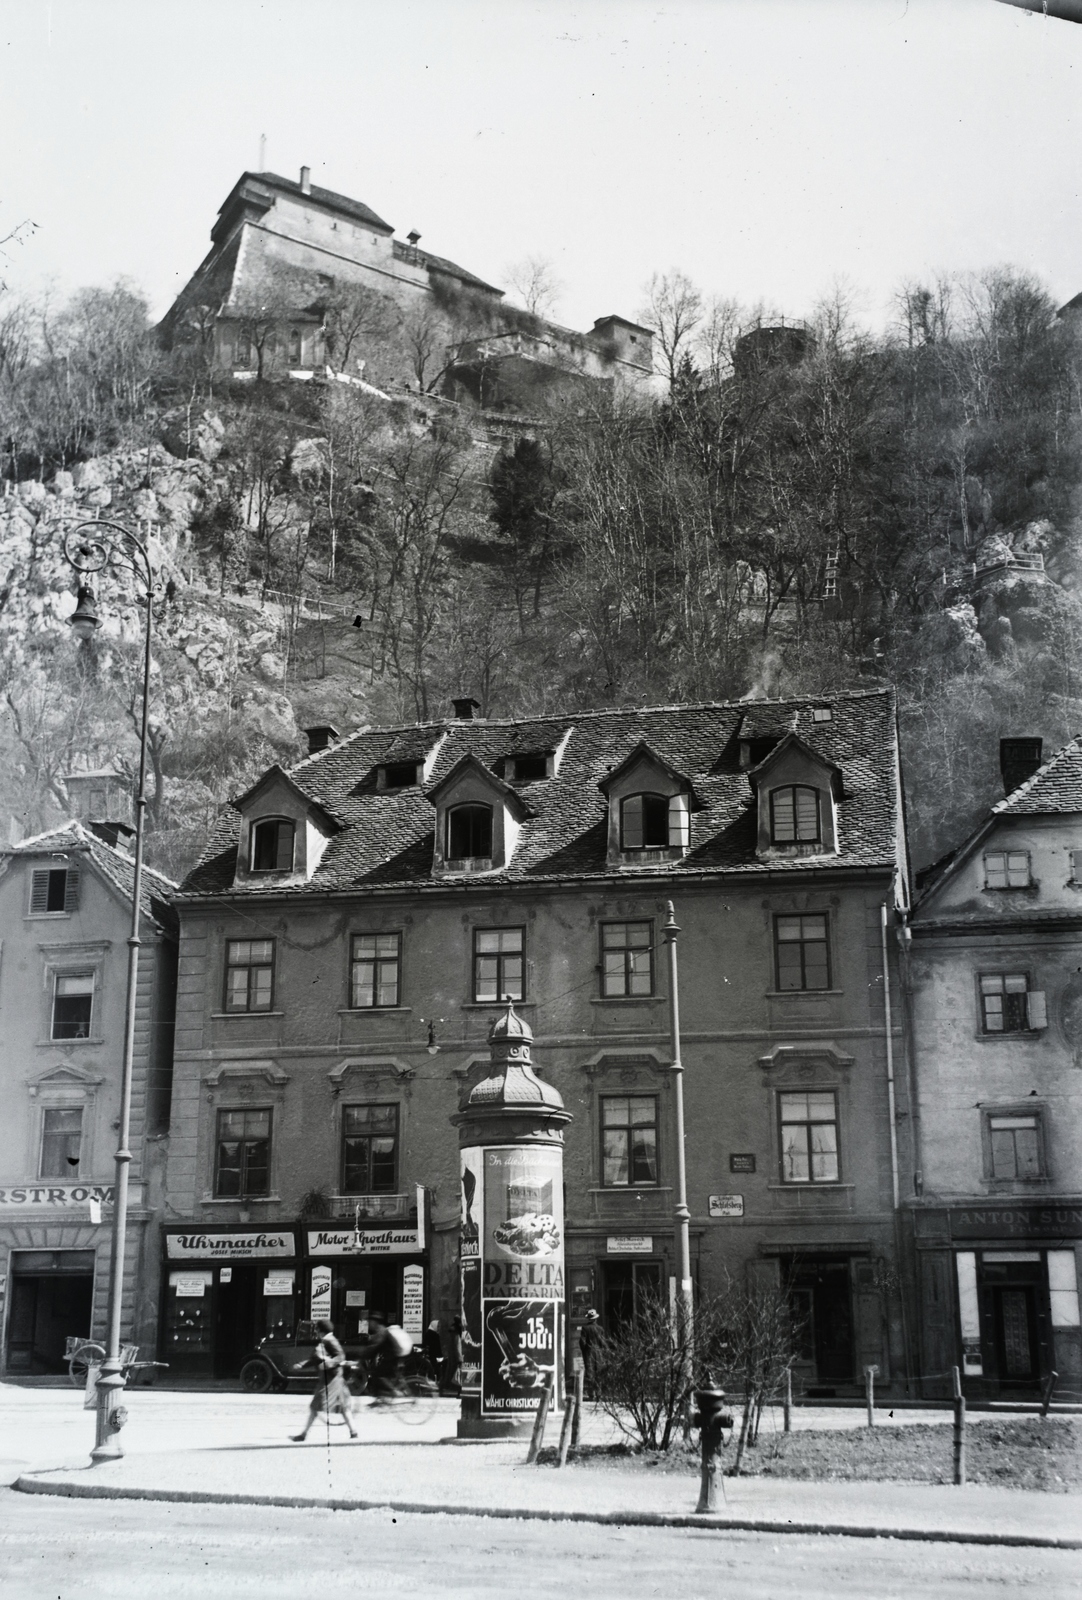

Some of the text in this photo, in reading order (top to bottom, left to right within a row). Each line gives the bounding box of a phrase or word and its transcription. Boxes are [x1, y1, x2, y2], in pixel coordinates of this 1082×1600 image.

[958, 1211, 1030, 1225] ANTON
[177, 1233, 287, 1249] Uhrmacher
[310, 1232, 349, 1249] Motor
[484, 1262, 564, 1286] DELTA
[526, 1317, 549, 1334] 15.
[518, 1332, 553, 1350] JULI!
[485, 1394, 505, 1408] WÄHLT
